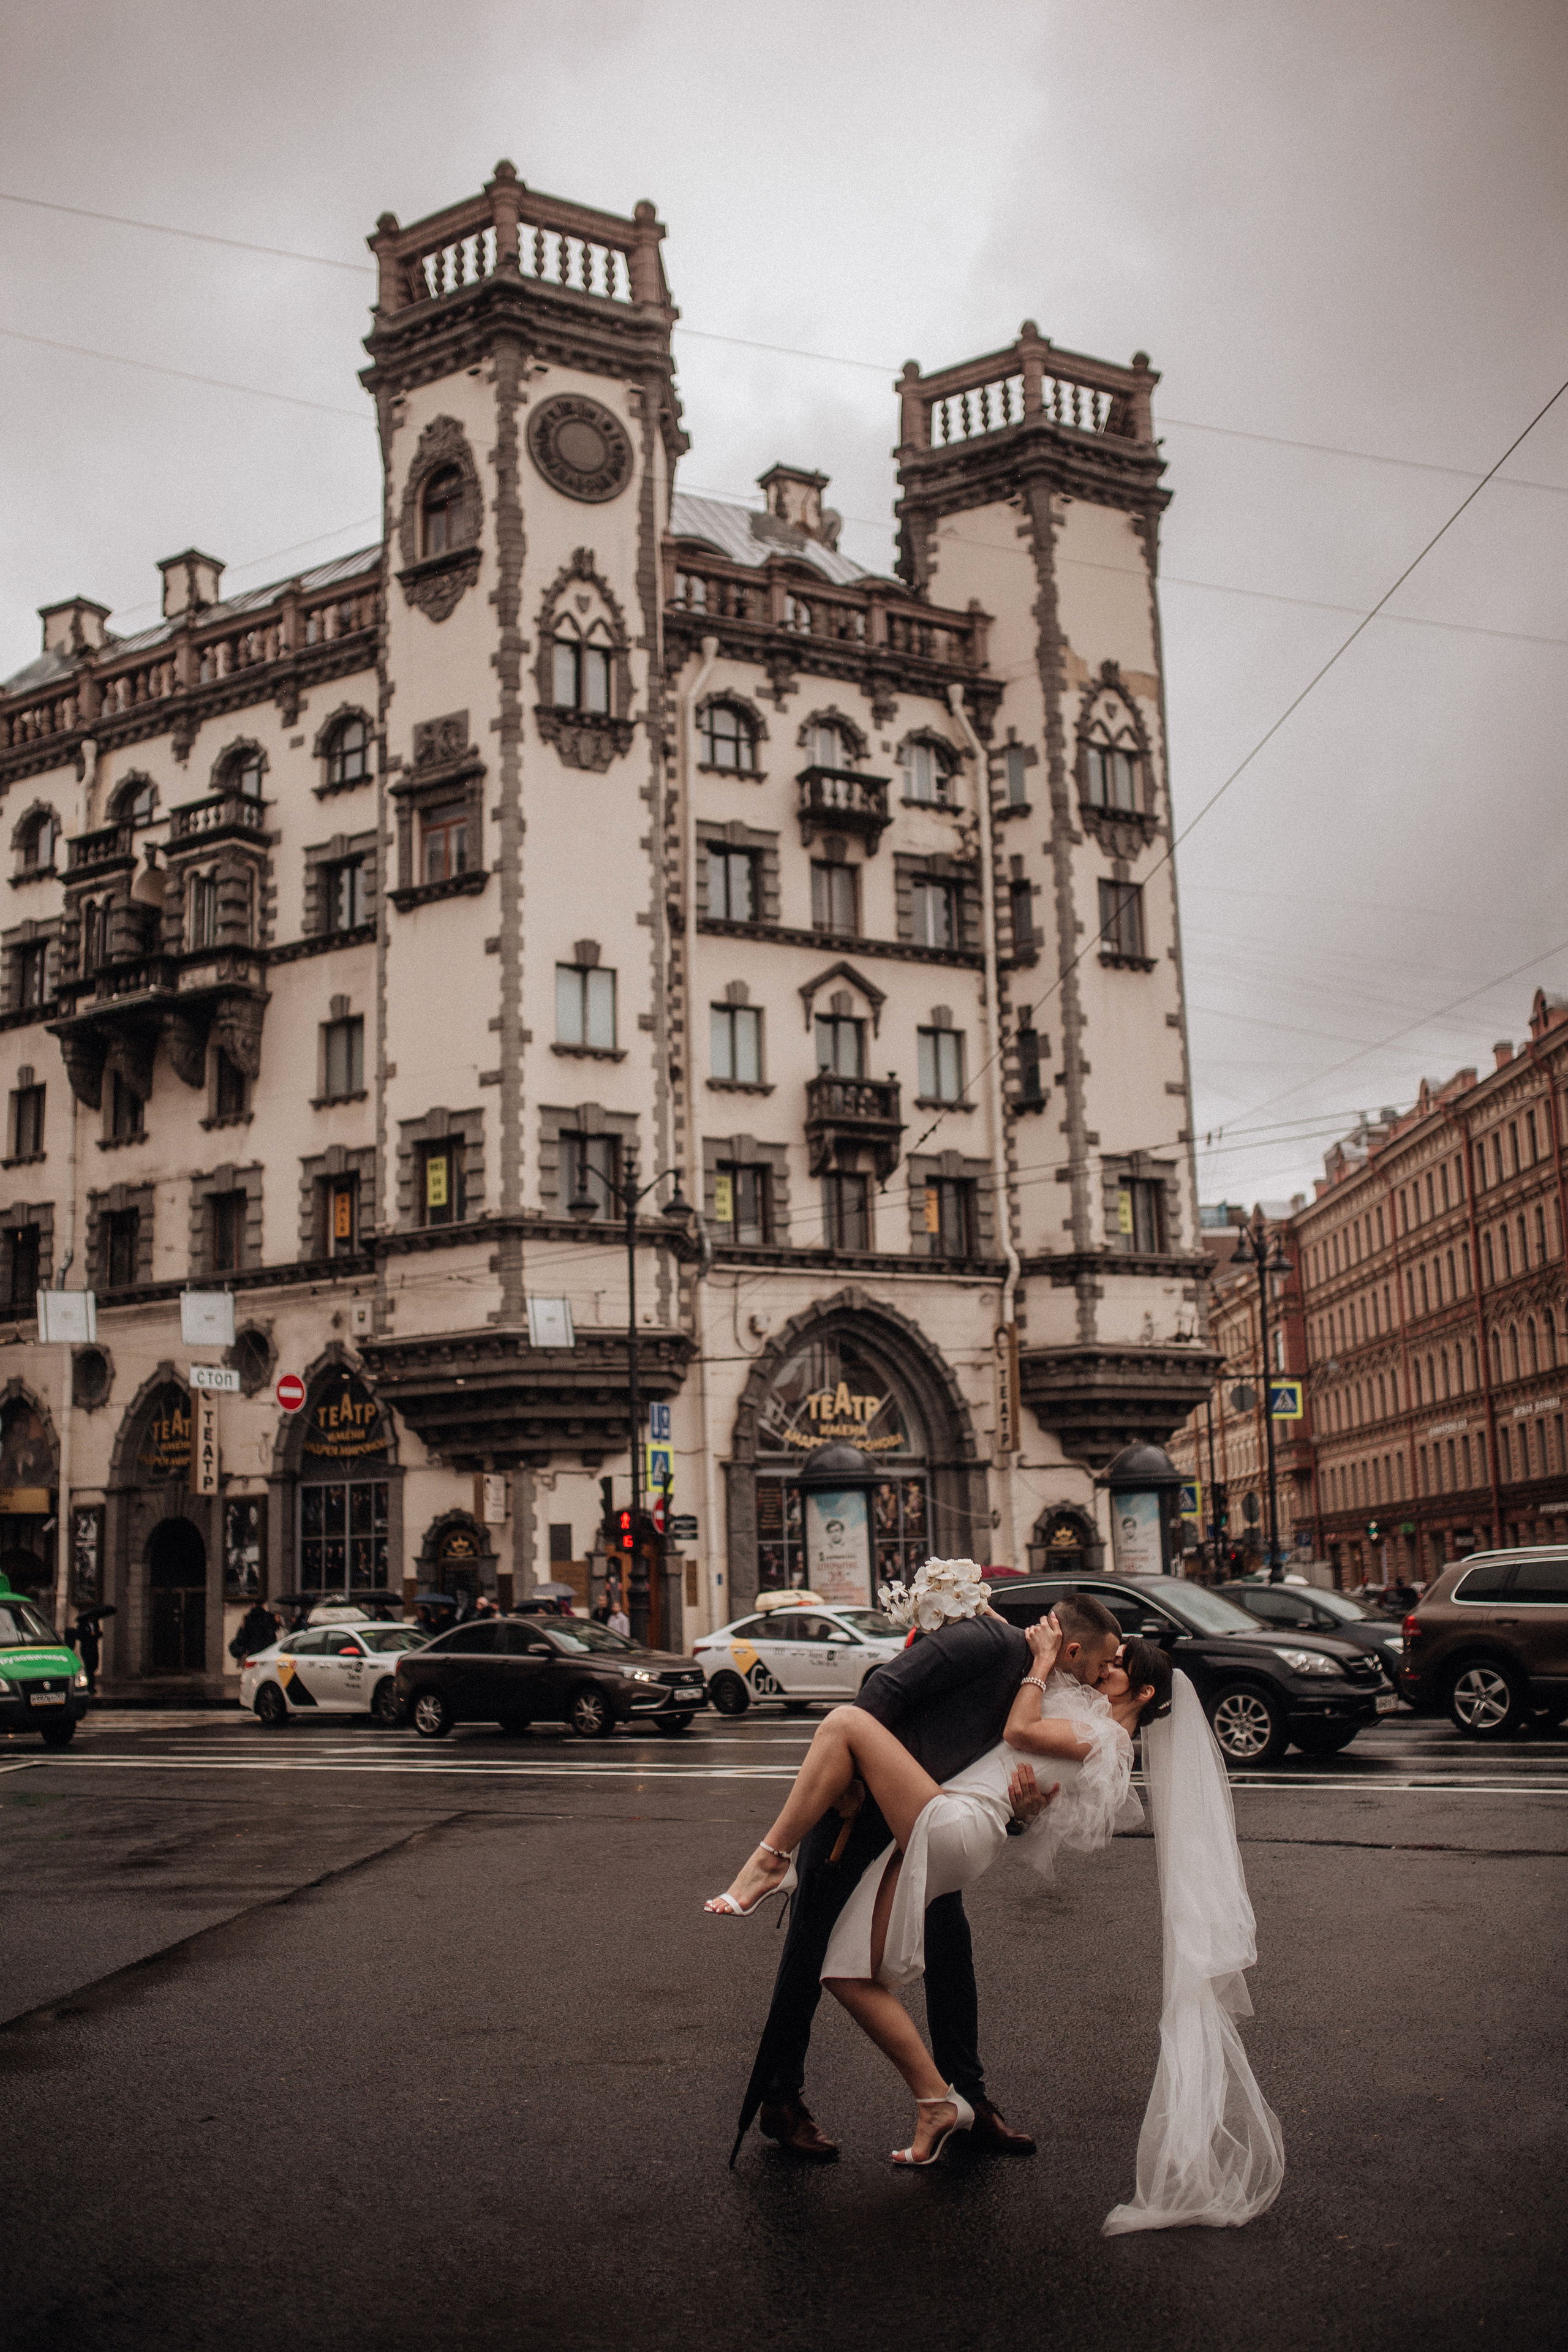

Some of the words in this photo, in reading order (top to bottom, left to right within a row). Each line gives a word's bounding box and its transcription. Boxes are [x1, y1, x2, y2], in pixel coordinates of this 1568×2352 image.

[197, 1371, 232, 1386] СТОП
[317, 1392, 376, 1428] ТЕАТР
[807, 1382, 880, 1420] ТЕАТР
[1000, 1370, 1009, 1446] ТЕАТР
[153, 1408, 191, 1440] ТЕАТ
[203, 1411, 213, 1490] ТЕАТР
[623, 1535, 633, 1548] 6
